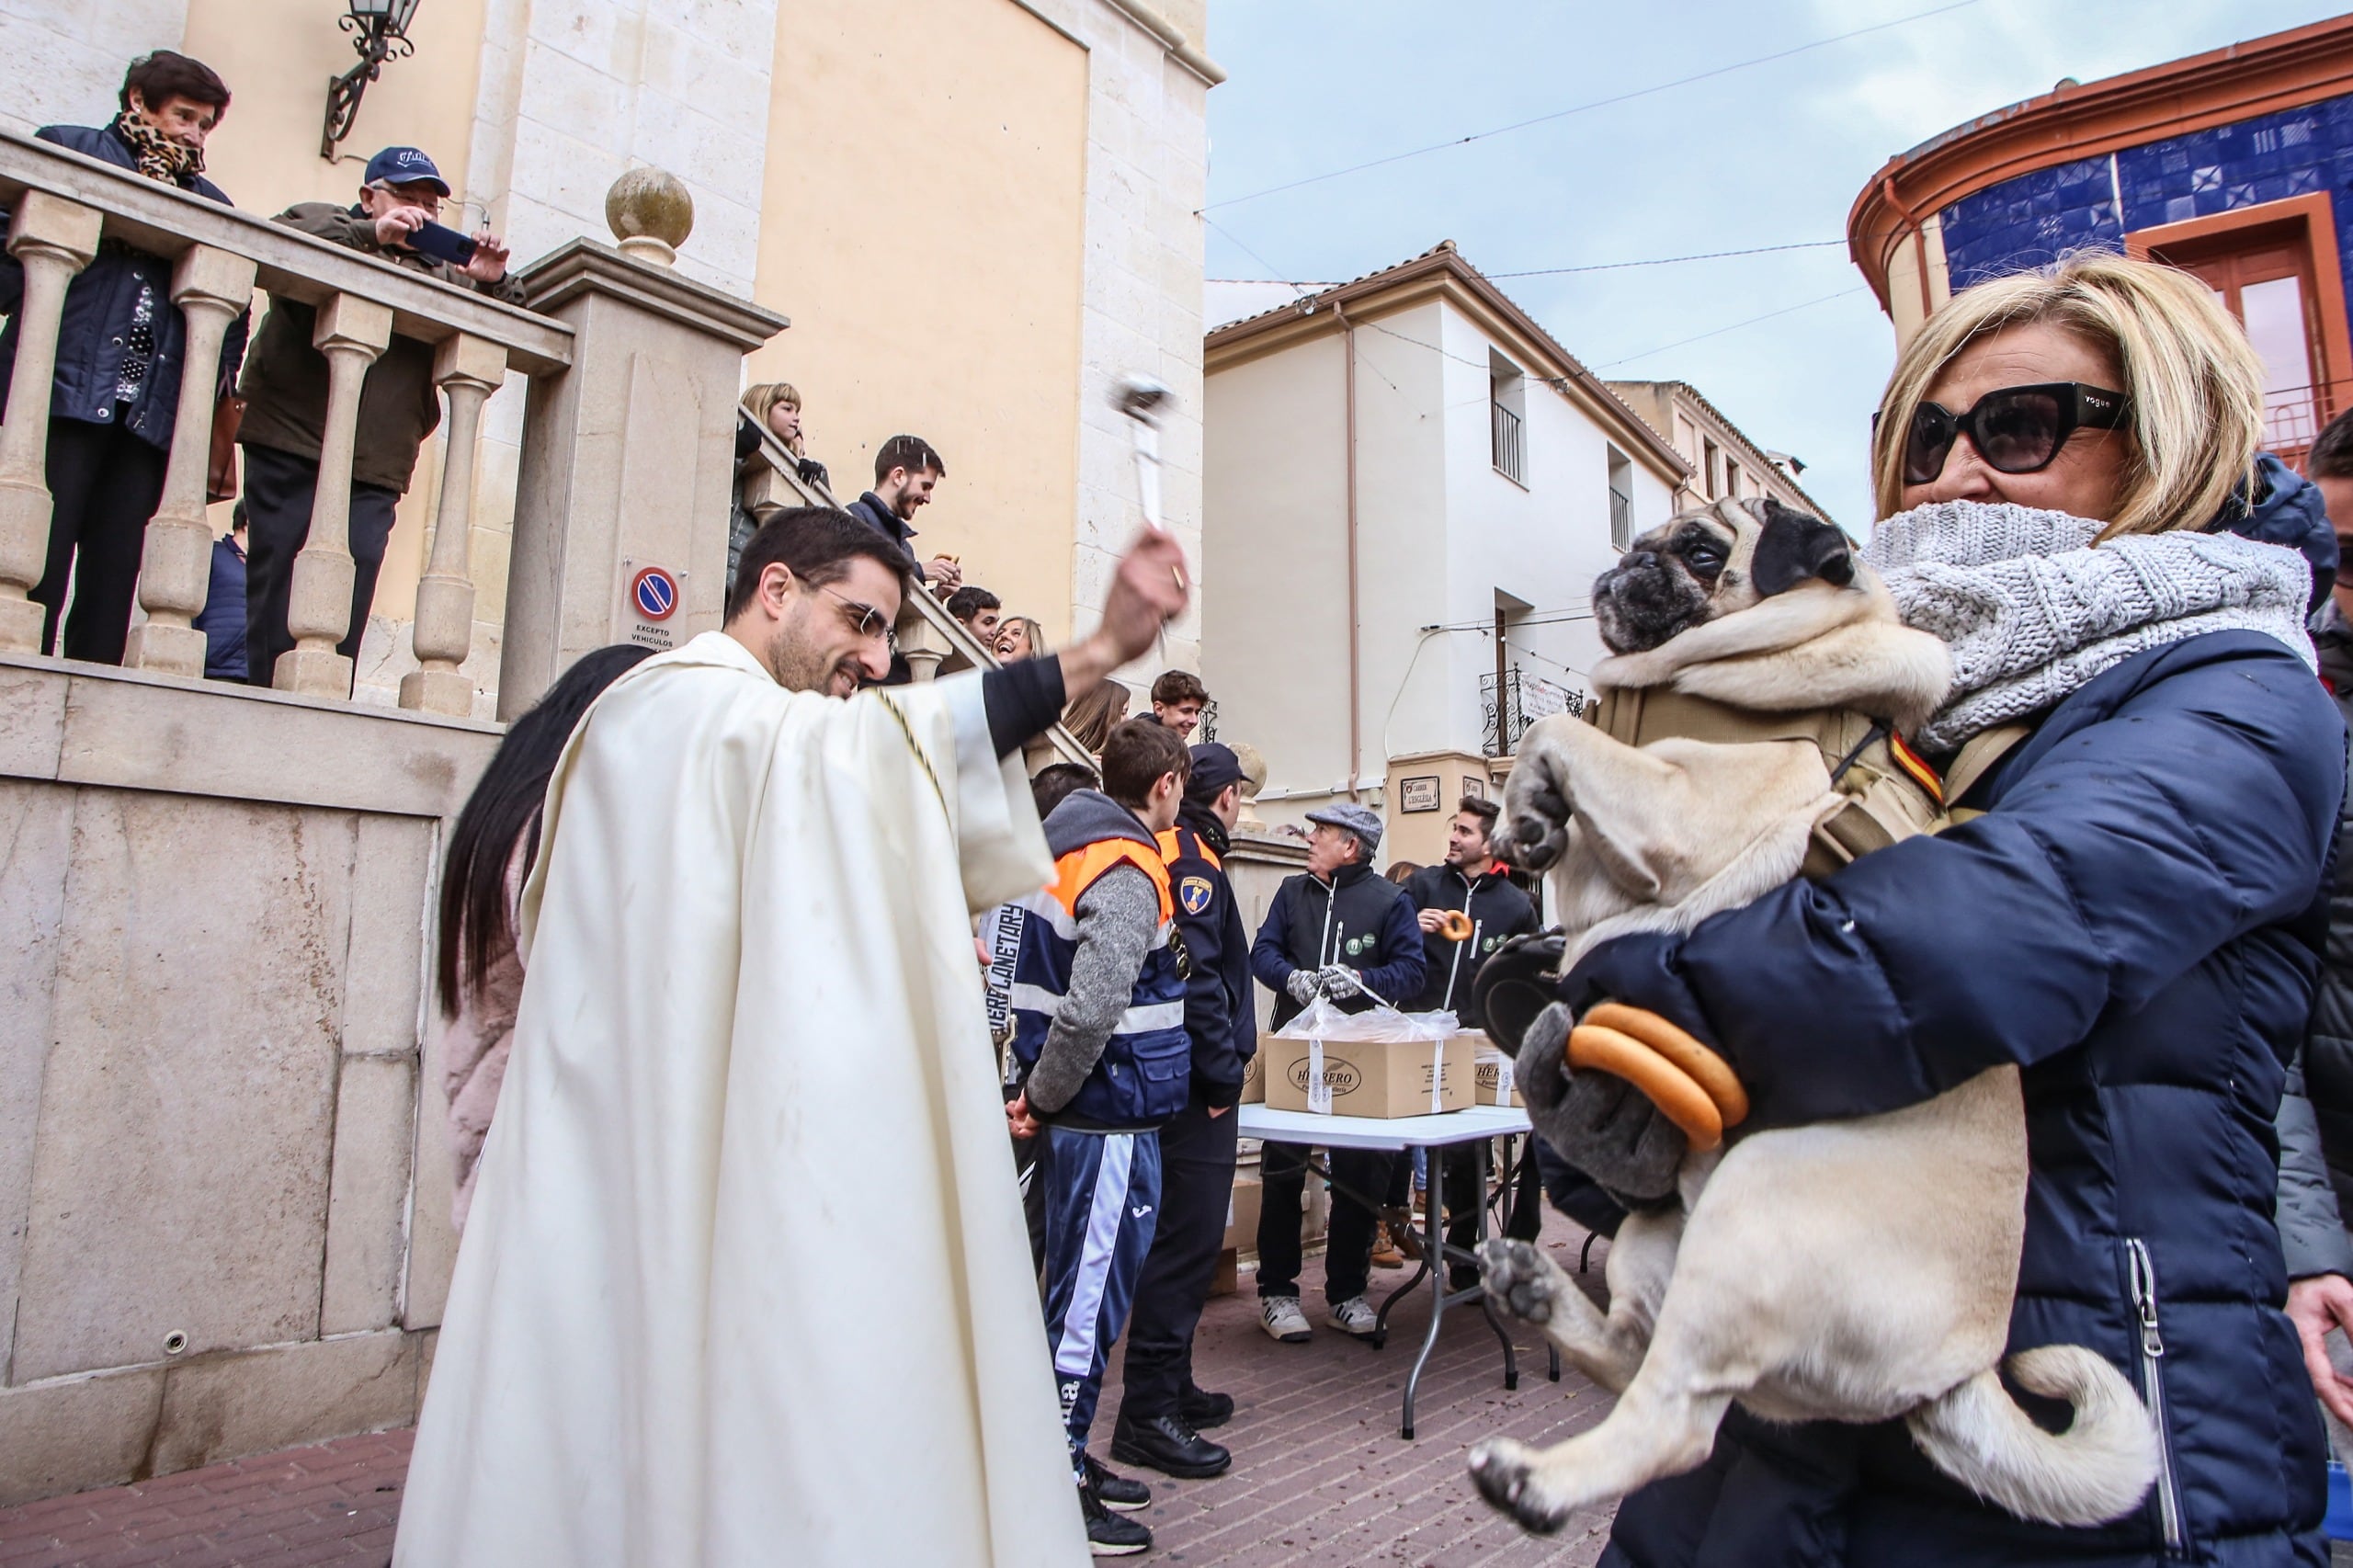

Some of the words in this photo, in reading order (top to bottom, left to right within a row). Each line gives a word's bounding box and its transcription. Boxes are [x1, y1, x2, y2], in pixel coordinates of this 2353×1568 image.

[2086, 395, 2110, 407] vogue
[636, 625, 669, 637] EXCEPTO
[631, 634, 673, 647] VEHICULOS
